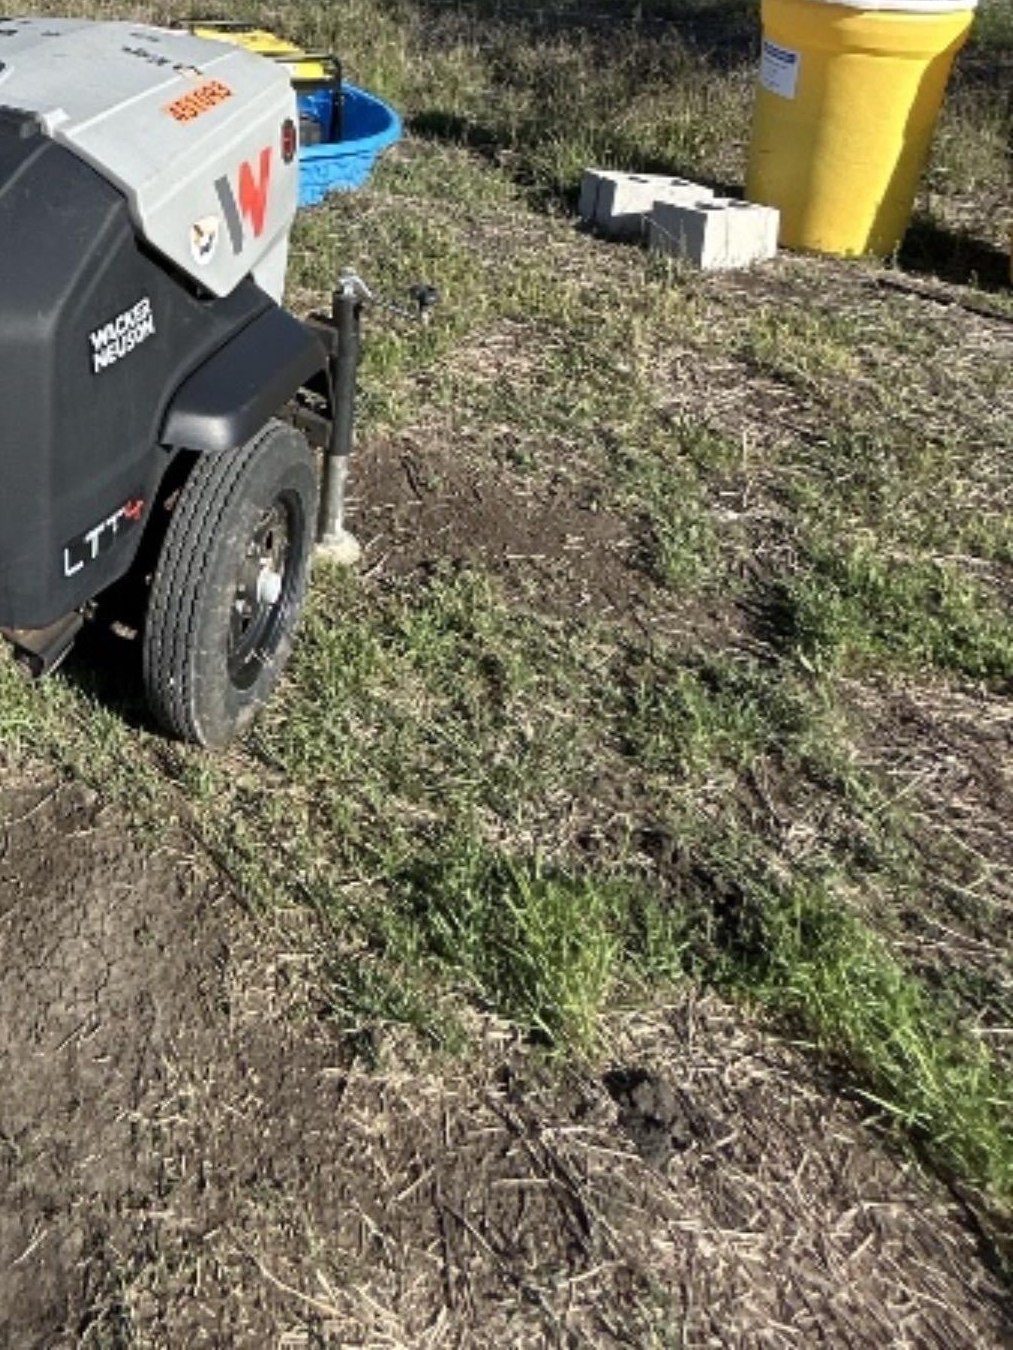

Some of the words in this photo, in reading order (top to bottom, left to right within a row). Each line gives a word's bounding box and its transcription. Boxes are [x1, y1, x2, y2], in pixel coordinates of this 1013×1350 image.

[89, 296, 152, 351] WACKER
[93, 314, 156, 373] NEUSON
[63, 500, 144, 578] LTT4
